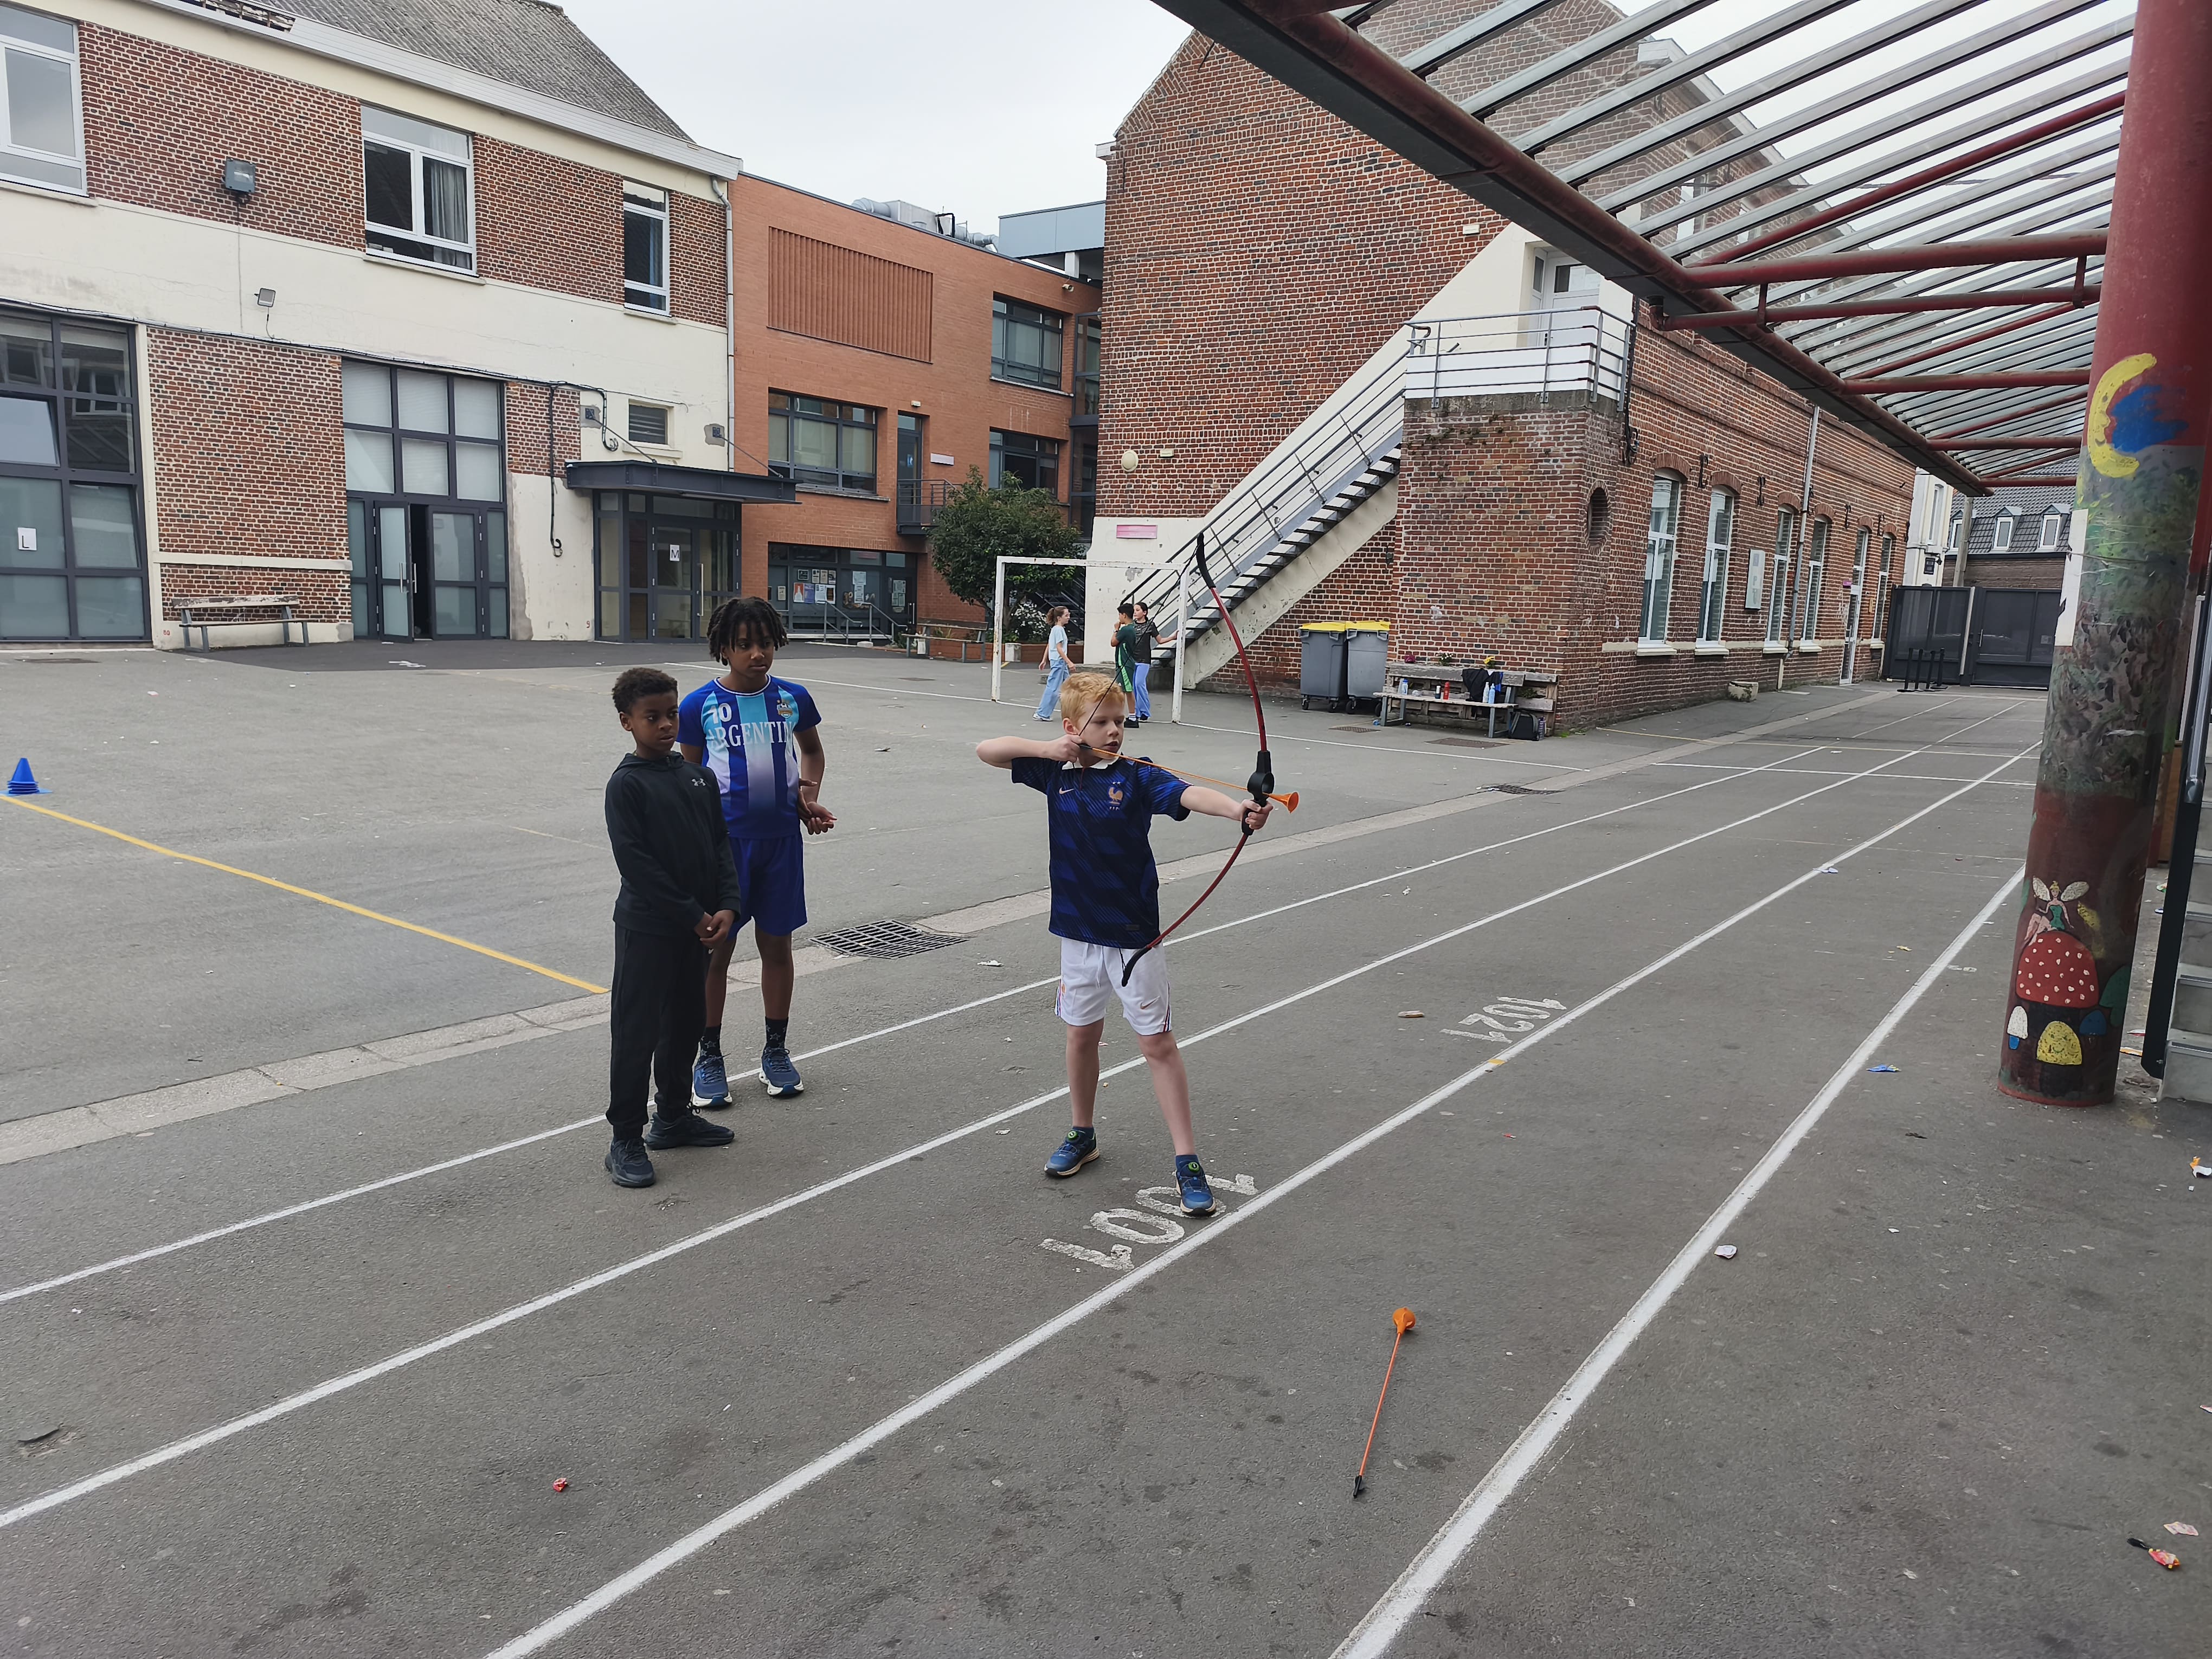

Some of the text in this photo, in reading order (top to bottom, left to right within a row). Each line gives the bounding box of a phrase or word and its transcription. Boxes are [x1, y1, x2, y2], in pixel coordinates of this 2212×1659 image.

[22, 535, 30, 549] L
[671, 549, 679, 558] M
[703, 703, 732, 724] 10
